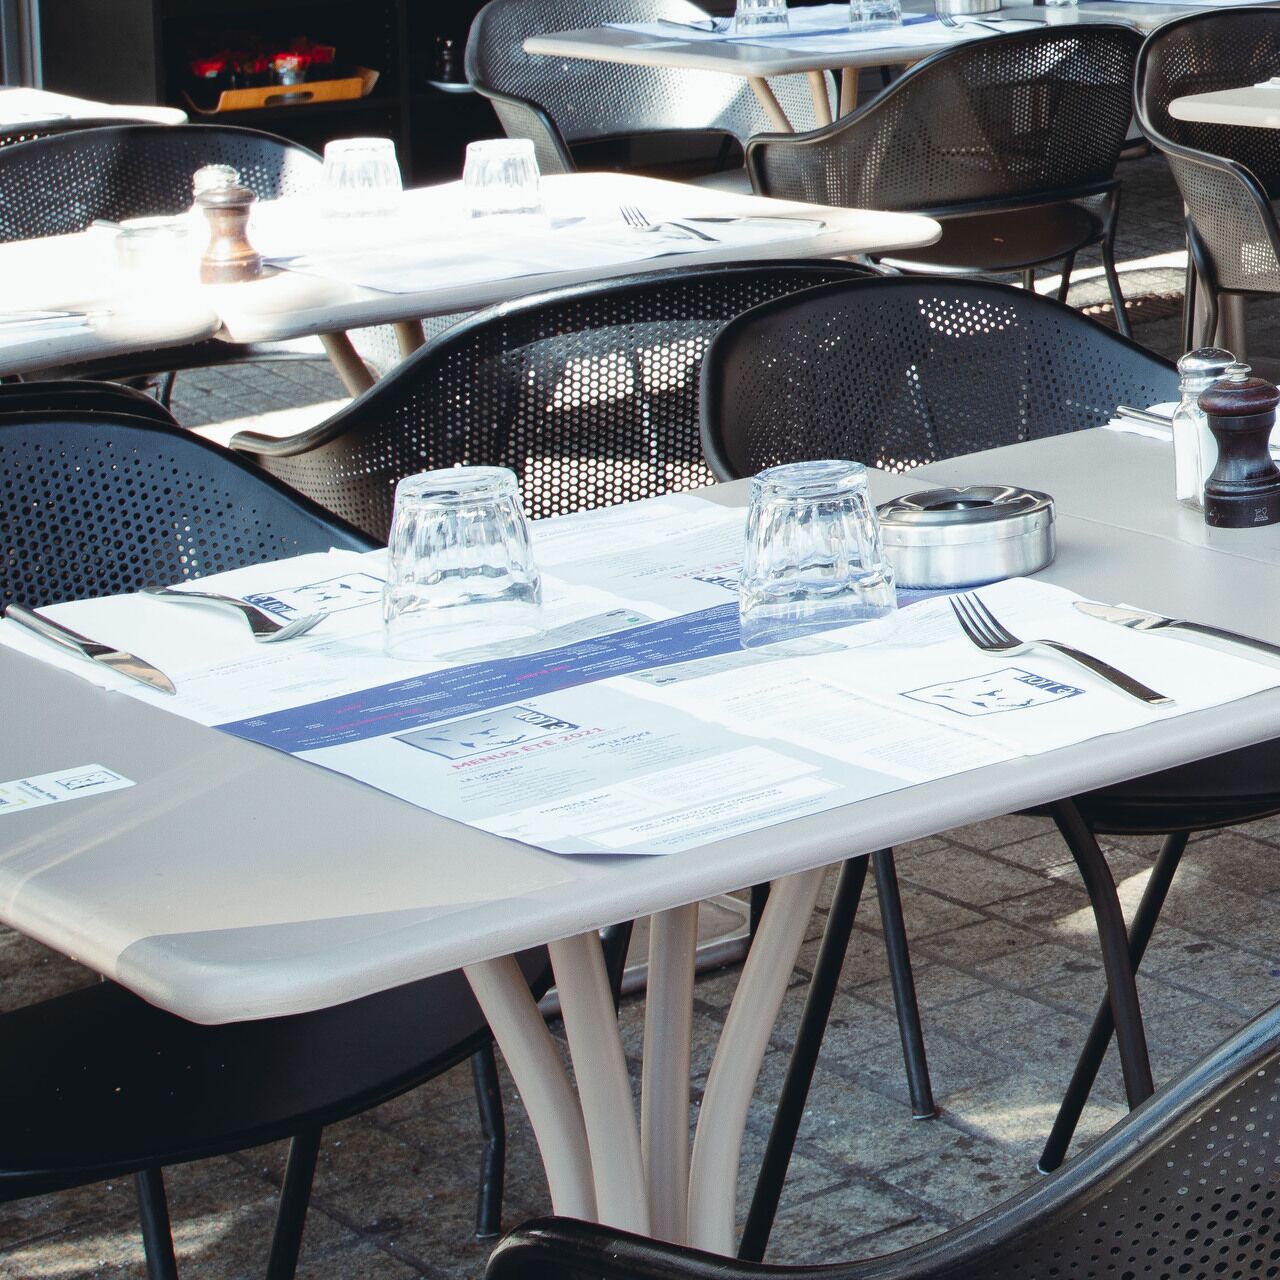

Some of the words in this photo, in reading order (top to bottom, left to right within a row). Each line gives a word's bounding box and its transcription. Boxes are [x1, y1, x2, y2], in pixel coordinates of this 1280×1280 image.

[451, 748, 519, 771] MENUS
[521, 736, 556, 757] ÉTÉ
[561, 726, 606, 743] 2021
